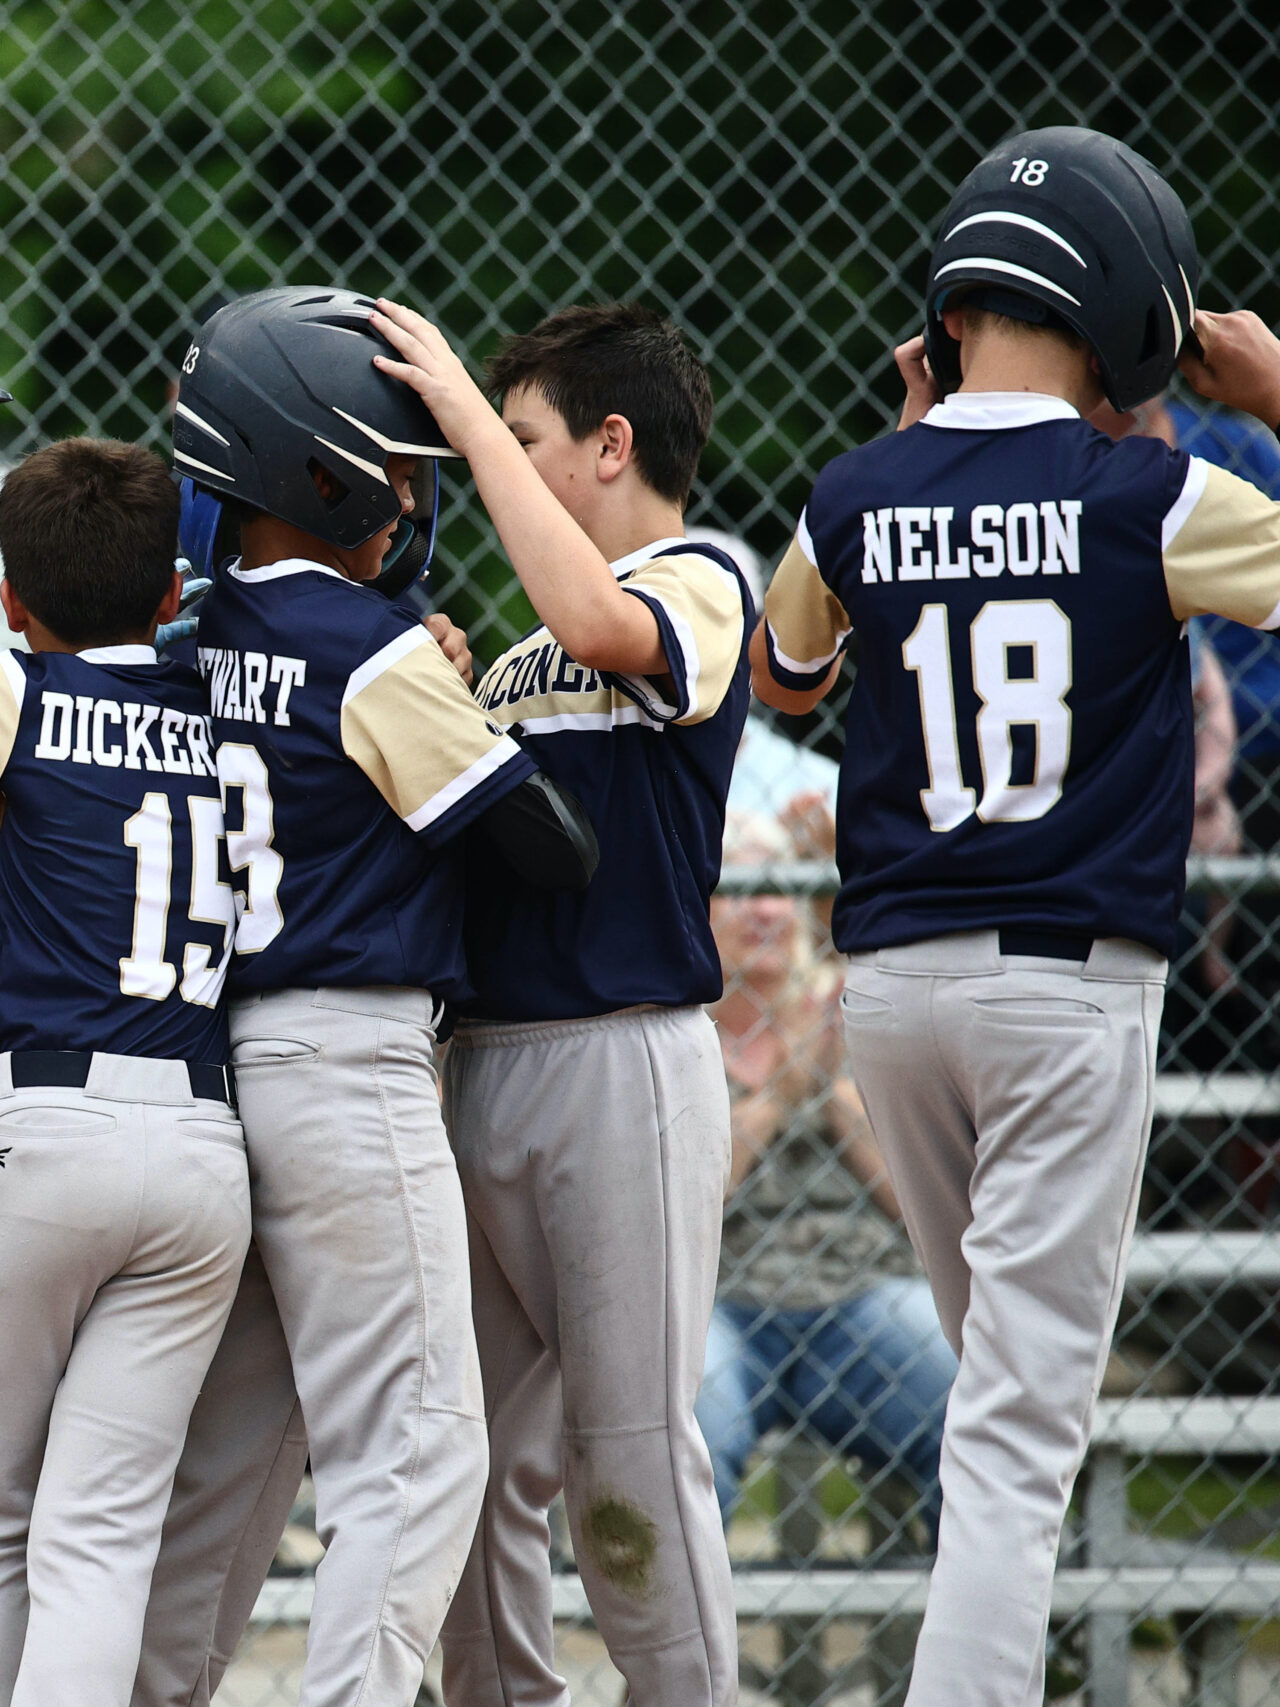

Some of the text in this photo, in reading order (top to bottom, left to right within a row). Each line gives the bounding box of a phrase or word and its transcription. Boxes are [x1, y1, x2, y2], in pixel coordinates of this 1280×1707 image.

[1009, 156, 1050, 187] 18
[860, 499, 1083, 584] NELSON
[901, 597, 1073, 833] 18
[119, 791, 240, 1010] 15
